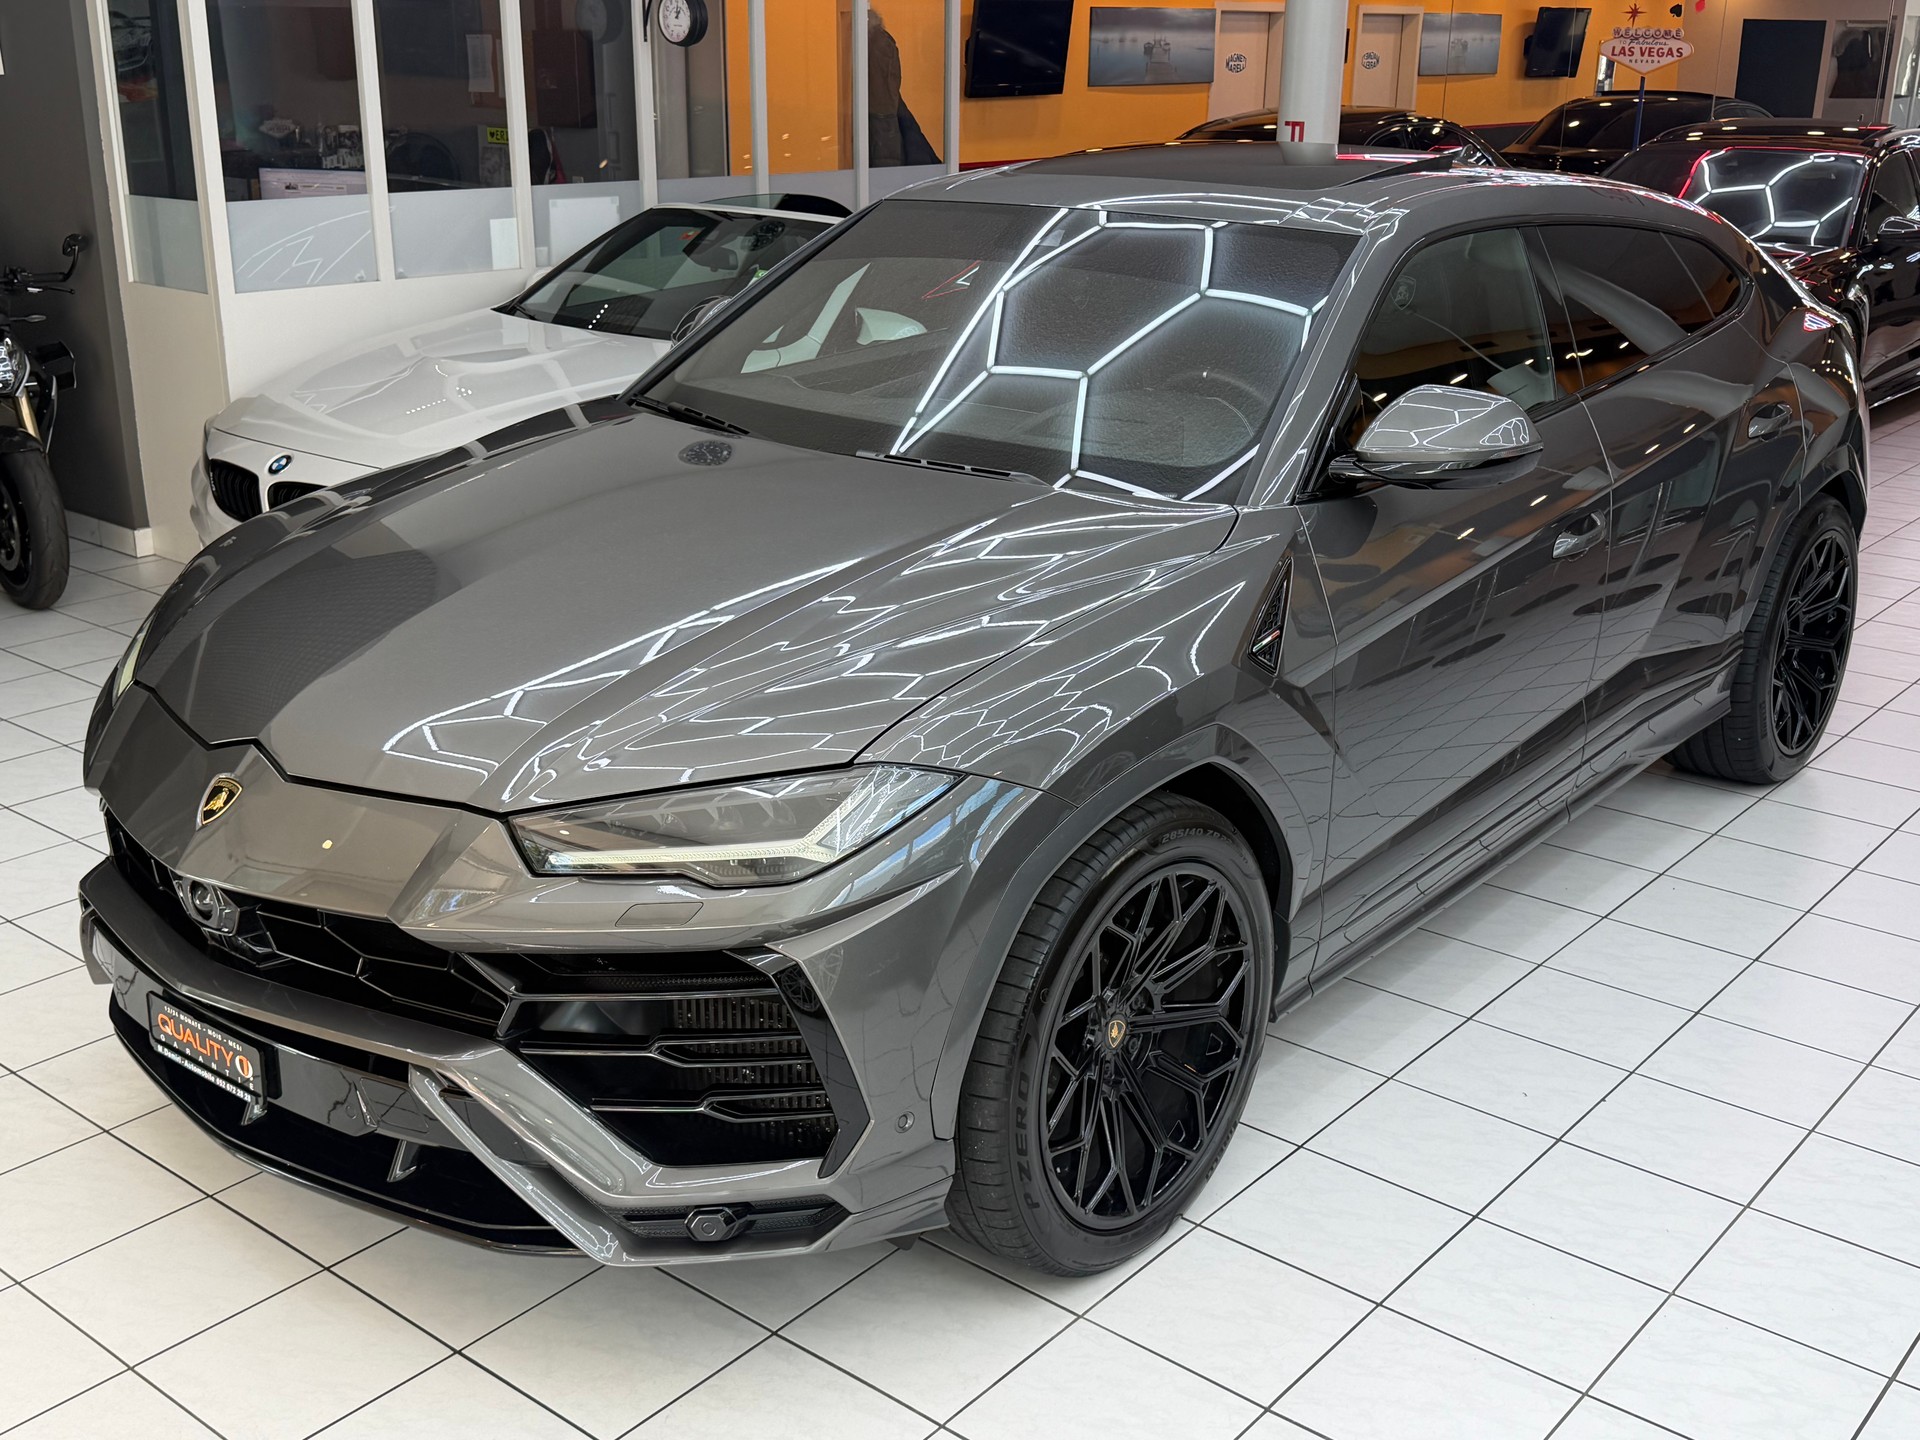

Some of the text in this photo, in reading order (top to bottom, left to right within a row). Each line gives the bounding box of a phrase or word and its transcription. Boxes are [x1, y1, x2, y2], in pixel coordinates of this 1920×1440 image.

[1613, 27, 1683, 38] WELCOME
[1611, 46, 1684, 58] LAS VEGAS
[1161, 827, 1204, 844] 285/40
[158, 1013, 234, 1067] QUALITY
[1015, 1071, 1040, 1210] P ZERO
